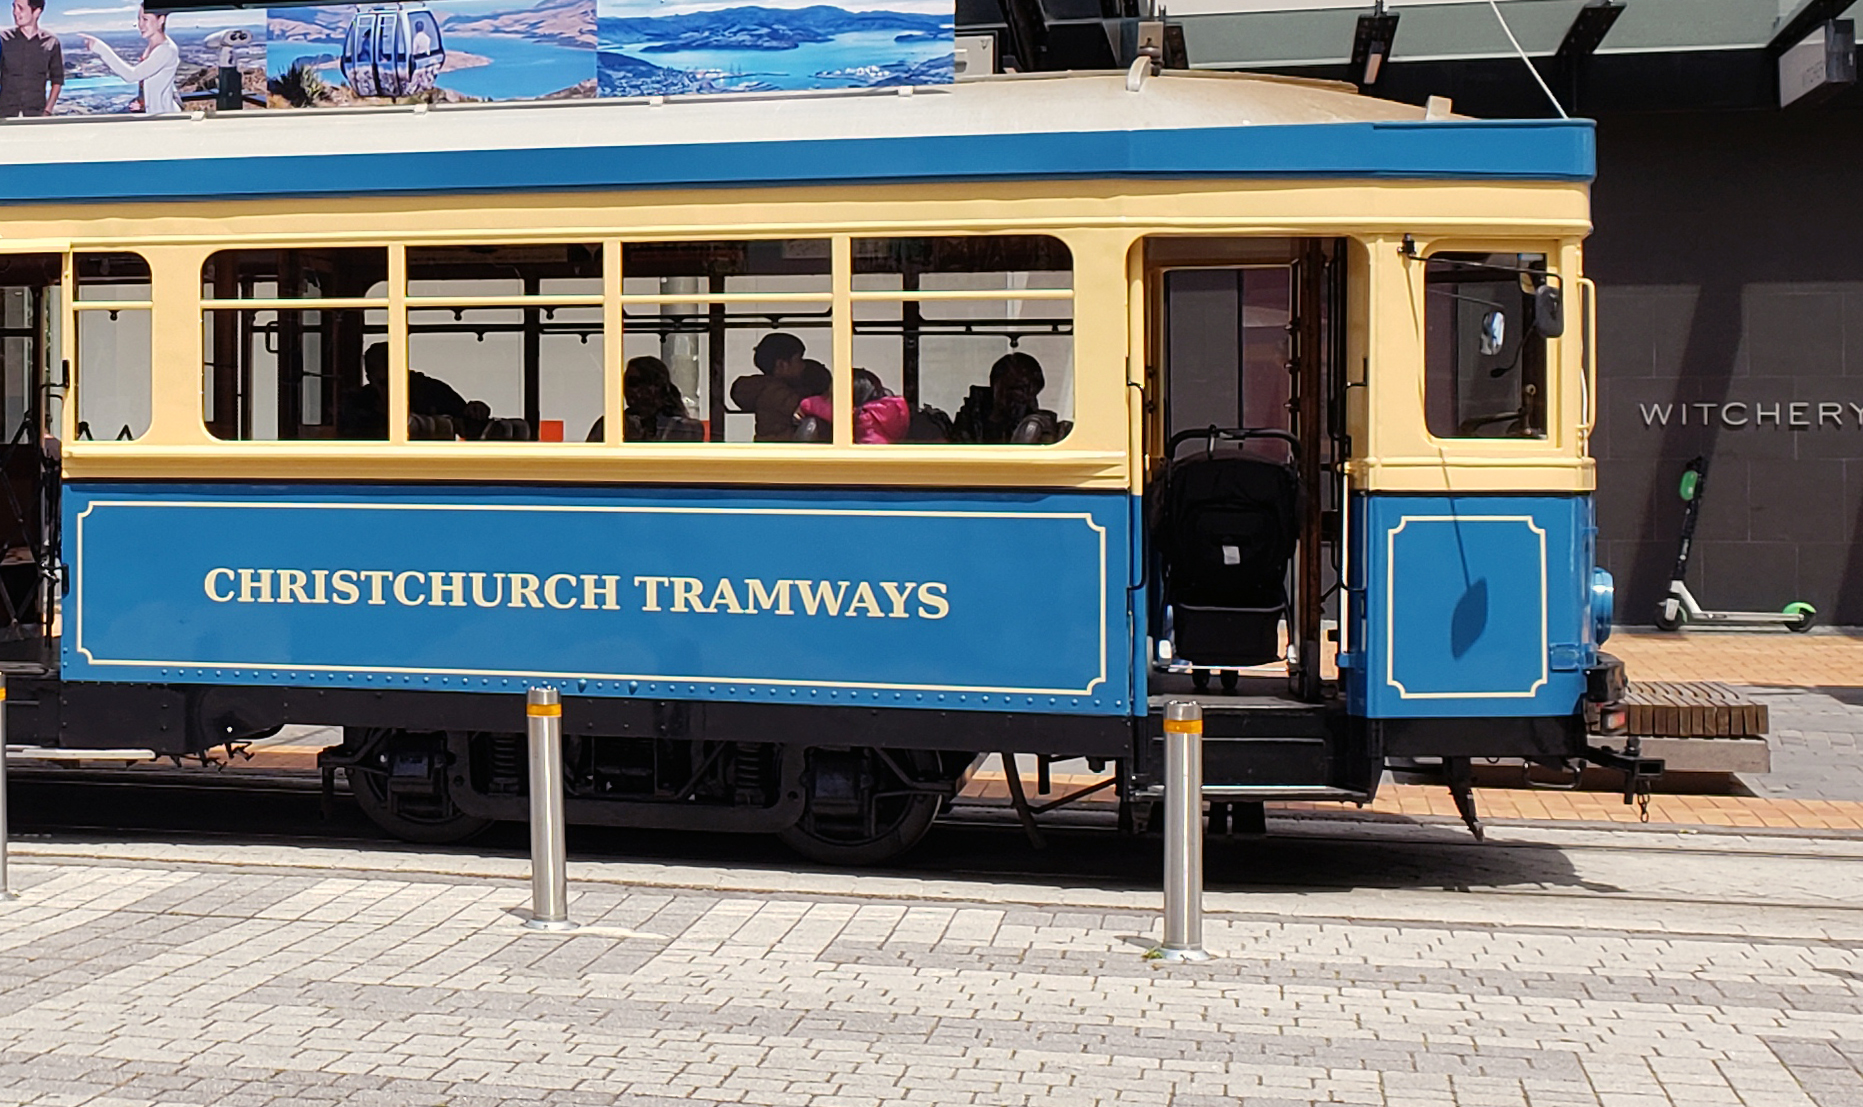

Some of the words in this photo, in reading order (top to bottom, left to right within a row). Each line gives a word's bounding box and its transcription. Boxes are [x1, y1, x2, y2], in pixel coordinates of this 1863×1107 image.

[1640, 401, 1863, 426] WITCHERY
[203, 567, 621, 611] CHRISTCHURCH
[634, 576, 951, 621] TRAMWAYS
